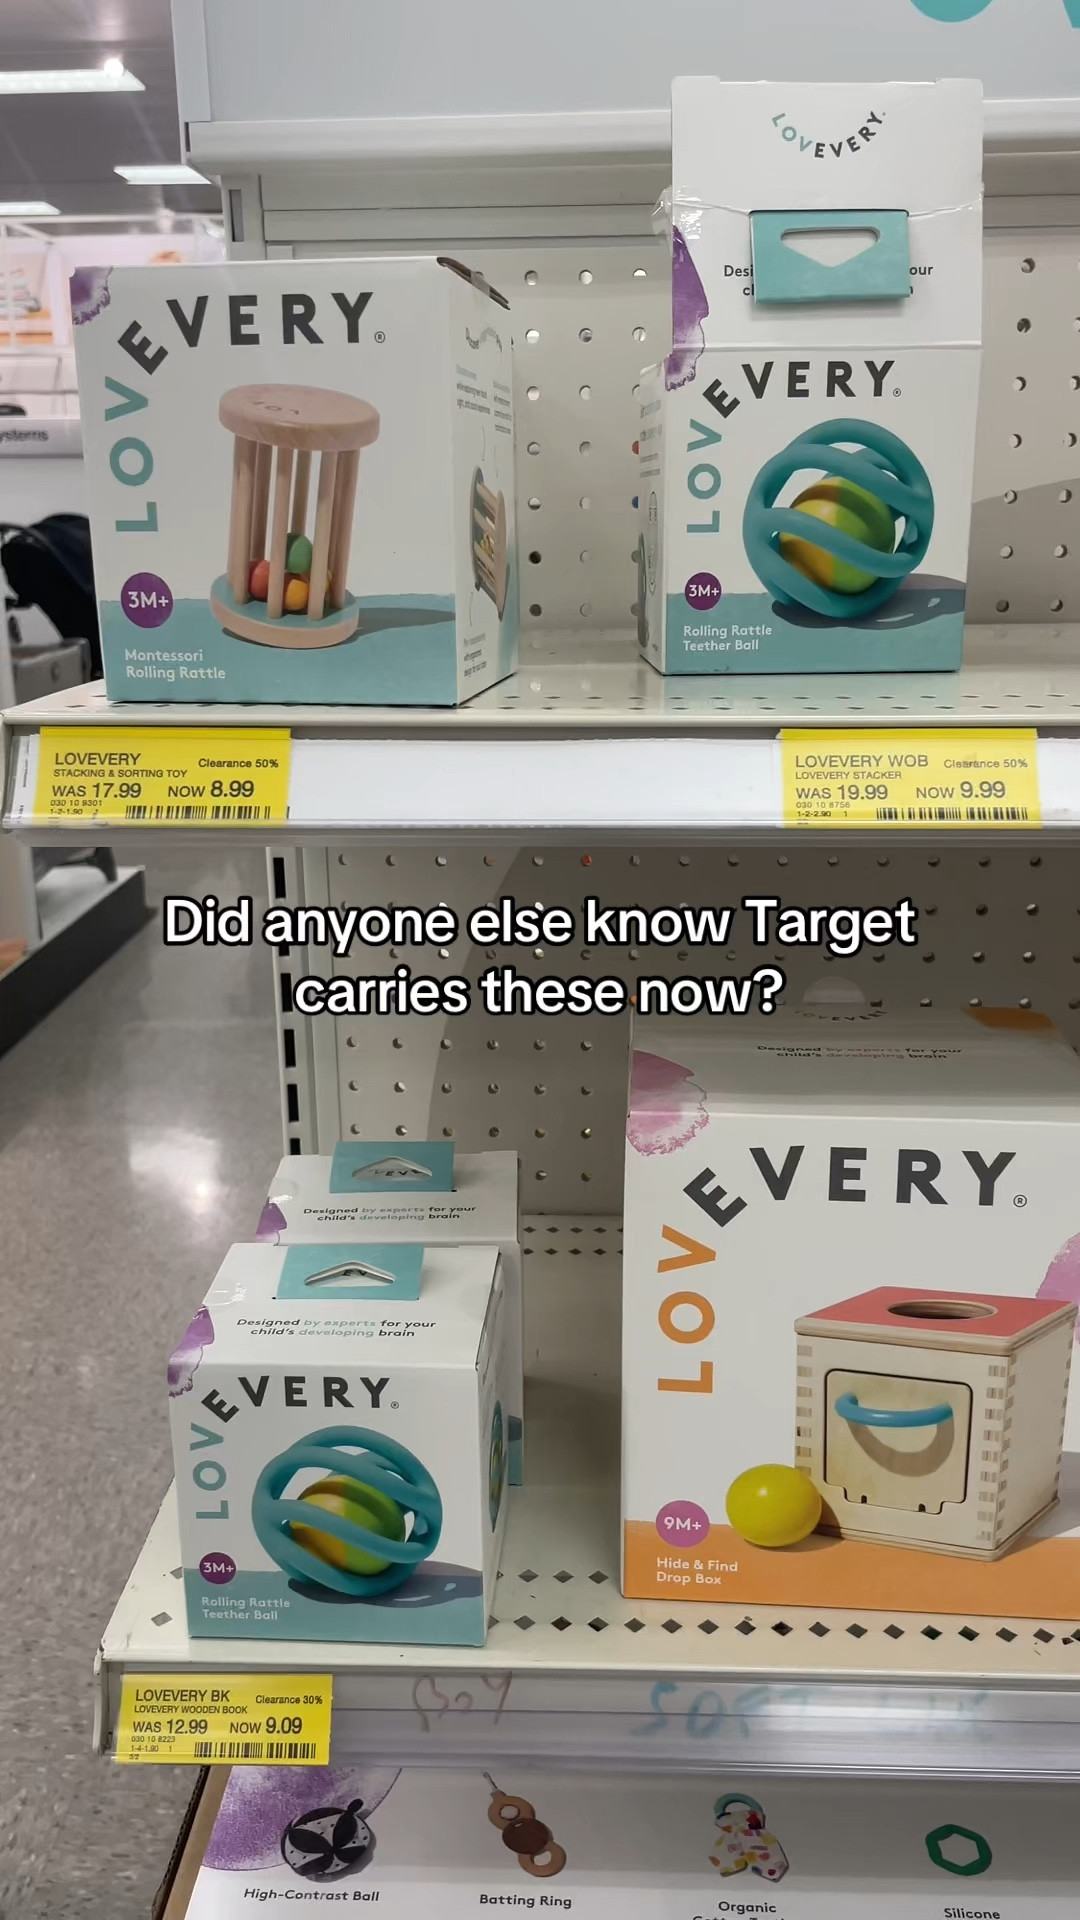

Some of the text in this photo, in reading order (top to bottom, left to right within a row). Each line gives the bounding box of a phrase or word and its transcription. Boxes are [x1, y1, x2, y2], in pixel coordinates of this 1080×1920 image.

[688, 585, 719, 597] 3M+
[128, 591, 169, 609] 3M+
[683, 624, 772, 639] Rolling Rattle
[683, 639, 759, 651] Teether Ball
[125, 649, 203, 662] Montessori
[126, 666, 226, 681] Rolling Rattle
[55, 752, 142, 765] LOVEVERY
[198, 758, 279, 768] Clearance 50%
[795, 754, 929, 767] LOVEVERY WOB
[943, 758, 1028, 768] Clearance 50%
[53, 768, 188, 778] STACKING & SORTING TOY
[795, 771, 902, 779] LOVEVERY STACKER
[52, 780, 255, 798] WAS 17.99 NOW 8.99
[796, 780, 1006, 800] WAS 19.99 NOW 9.99
[303, 1207, 359, 1215] Designed
[237, 1319, 300, 1327] Designed
[303, 1319, 319, 1327] by
[323, 1320, 376, 1328] experts
[250, 1327, 415, 1338] child's developing brain
[664, 1516, 702, 1531] 9M+
[203, 1562, 234, 1573] 3M+
[656, 1556, 738, 1572] Hide & Find
[656, 1571, 721, 1586] Drop Box
[201, 1596, 291, 1609] Rolling Rattle
[202, 1609, 278, 1620] Teether Ball
[136, 1689, 230, 1702] LOVEVERY BK
[255, 1695, 323, 1704] Clearance 30%
[134, 1705, 248, 1714] LOVEVERY WOODEN BOOK
[133, 1716, 302, 1734] WAS 12.99 NOW 9.09
[244, 1888, 380, 1901] High-Contrast Ball
[479, 1894, 572, 1909] Batting Ring
[718, 1901, 777, 1915] Organic
[943, 1907, 1000, 1919] Silicone
